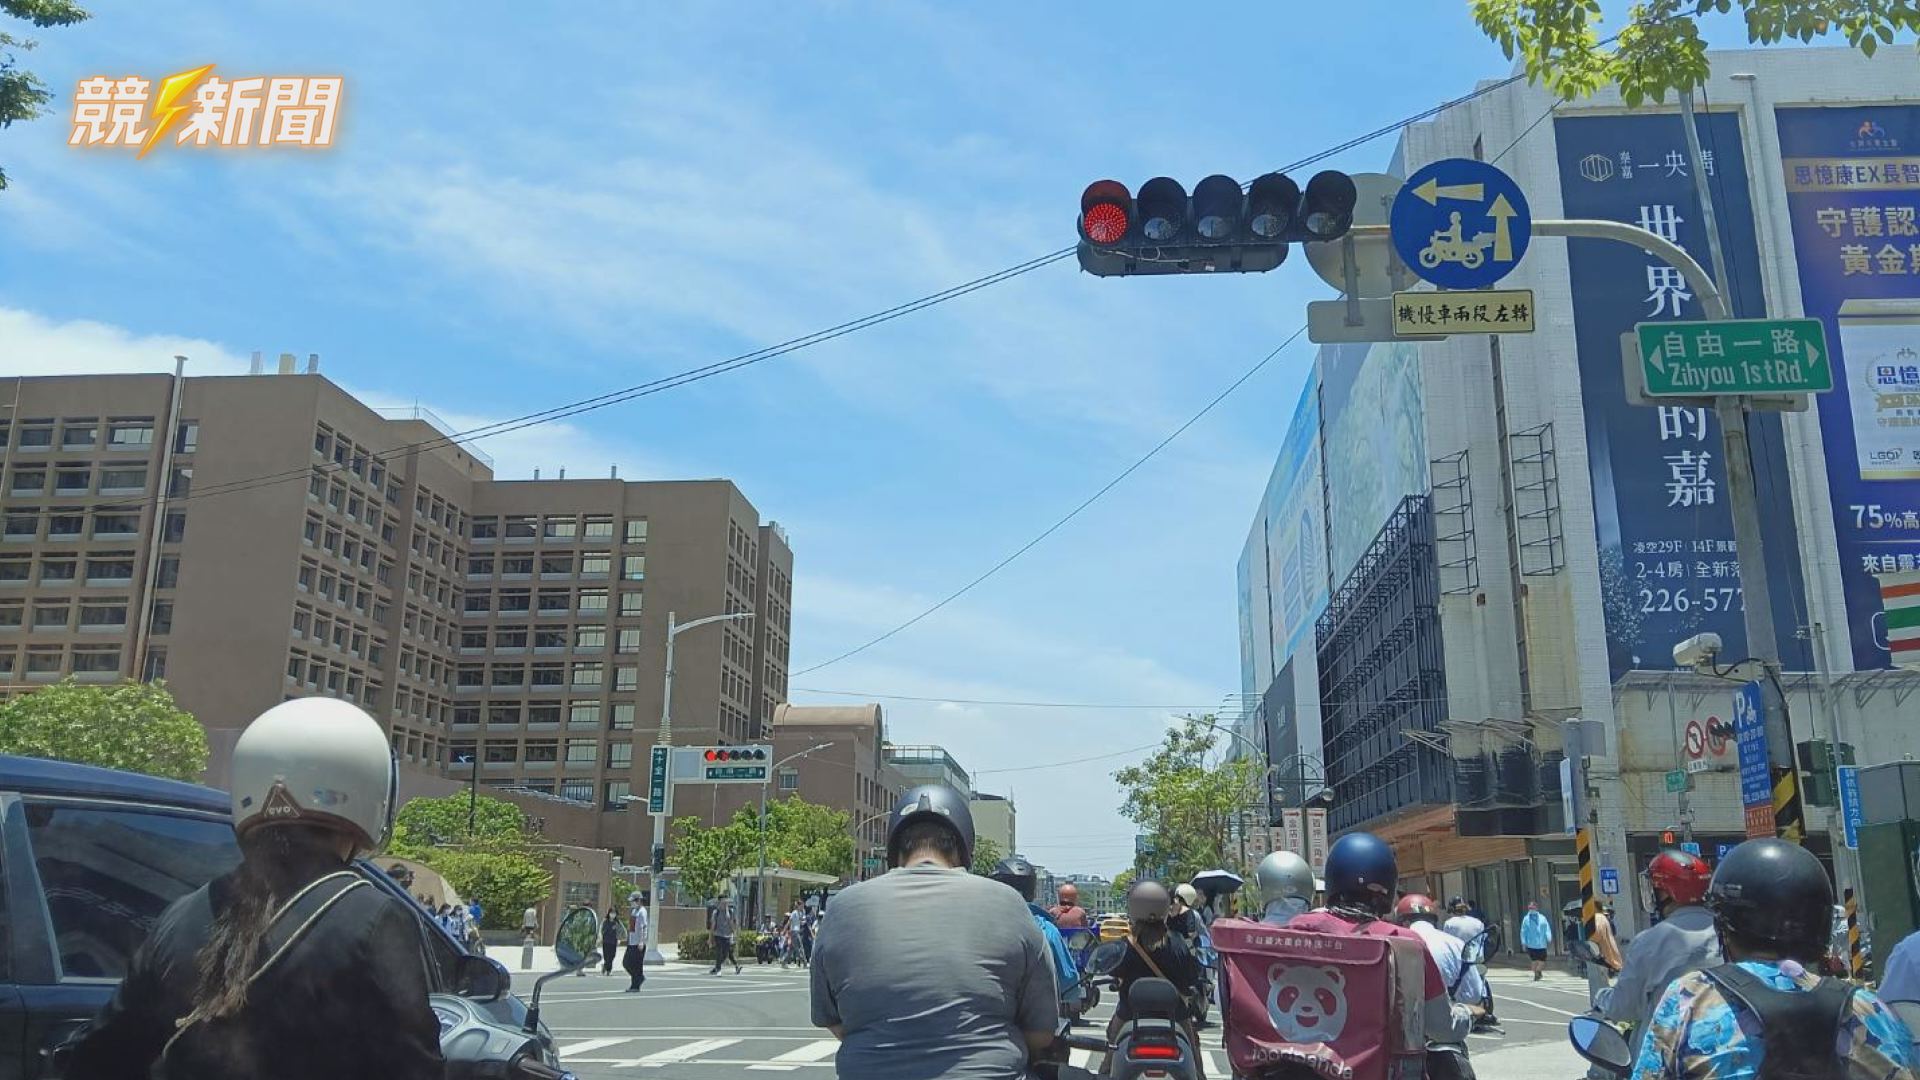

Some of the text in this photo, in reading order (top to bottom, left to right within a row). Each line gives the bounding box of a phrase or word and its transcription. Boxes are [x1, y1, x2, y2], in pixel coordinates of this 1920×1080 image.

[1816, 207, 1920, 238] 守護認
[1399, 303, 1529, 325] 機慢車兩段左轉
[1663, 328, 1799, 358] 自由一路
[1668, 362, 1735, 390] Zihyou
